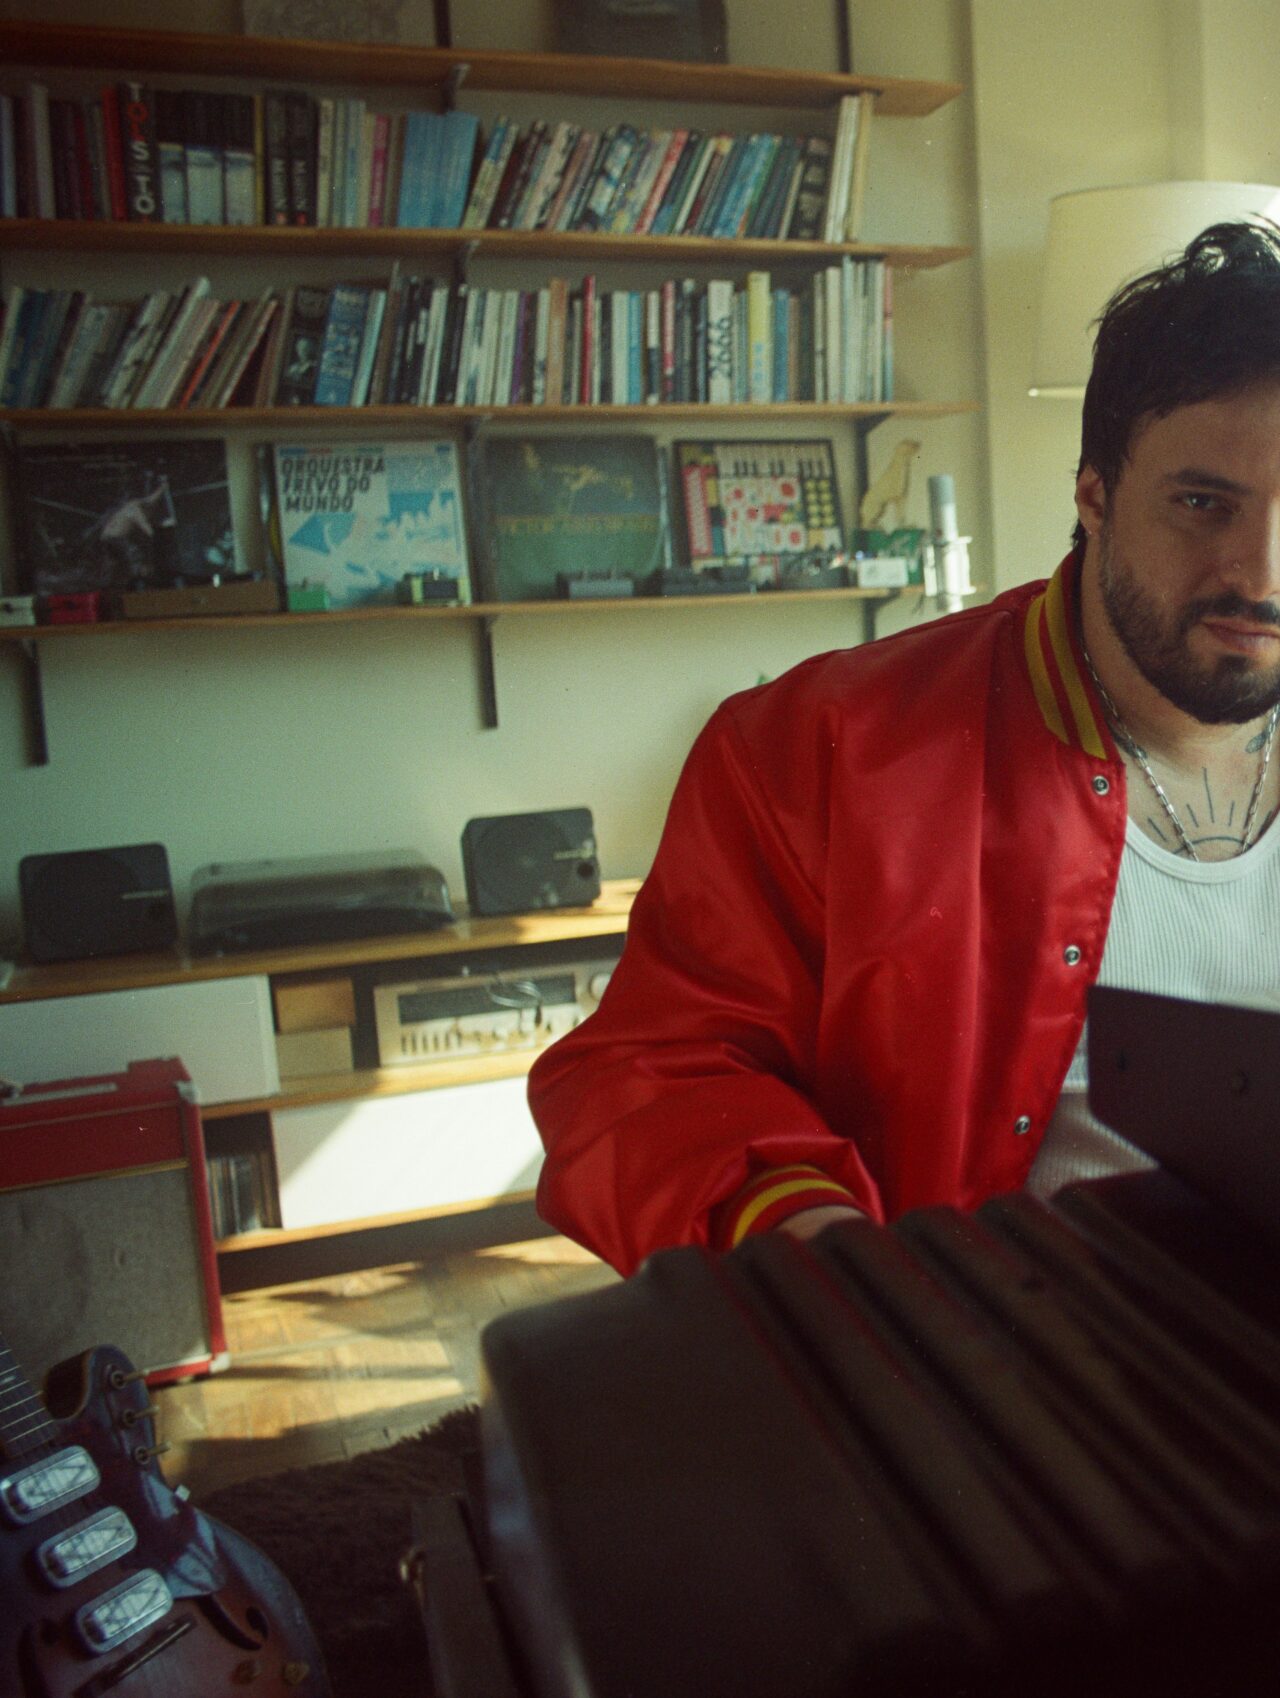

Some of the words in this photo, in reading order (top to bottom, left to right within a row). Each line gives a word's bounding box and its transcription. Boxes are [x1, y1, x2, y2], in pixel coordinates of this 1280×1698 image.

[706, 315, 733, 378] 2666
[282, 457, 385, 475] ORQUESTRA
[346, 475, 370, 492] DO
[285, 494, 355, 512] MUNDO
